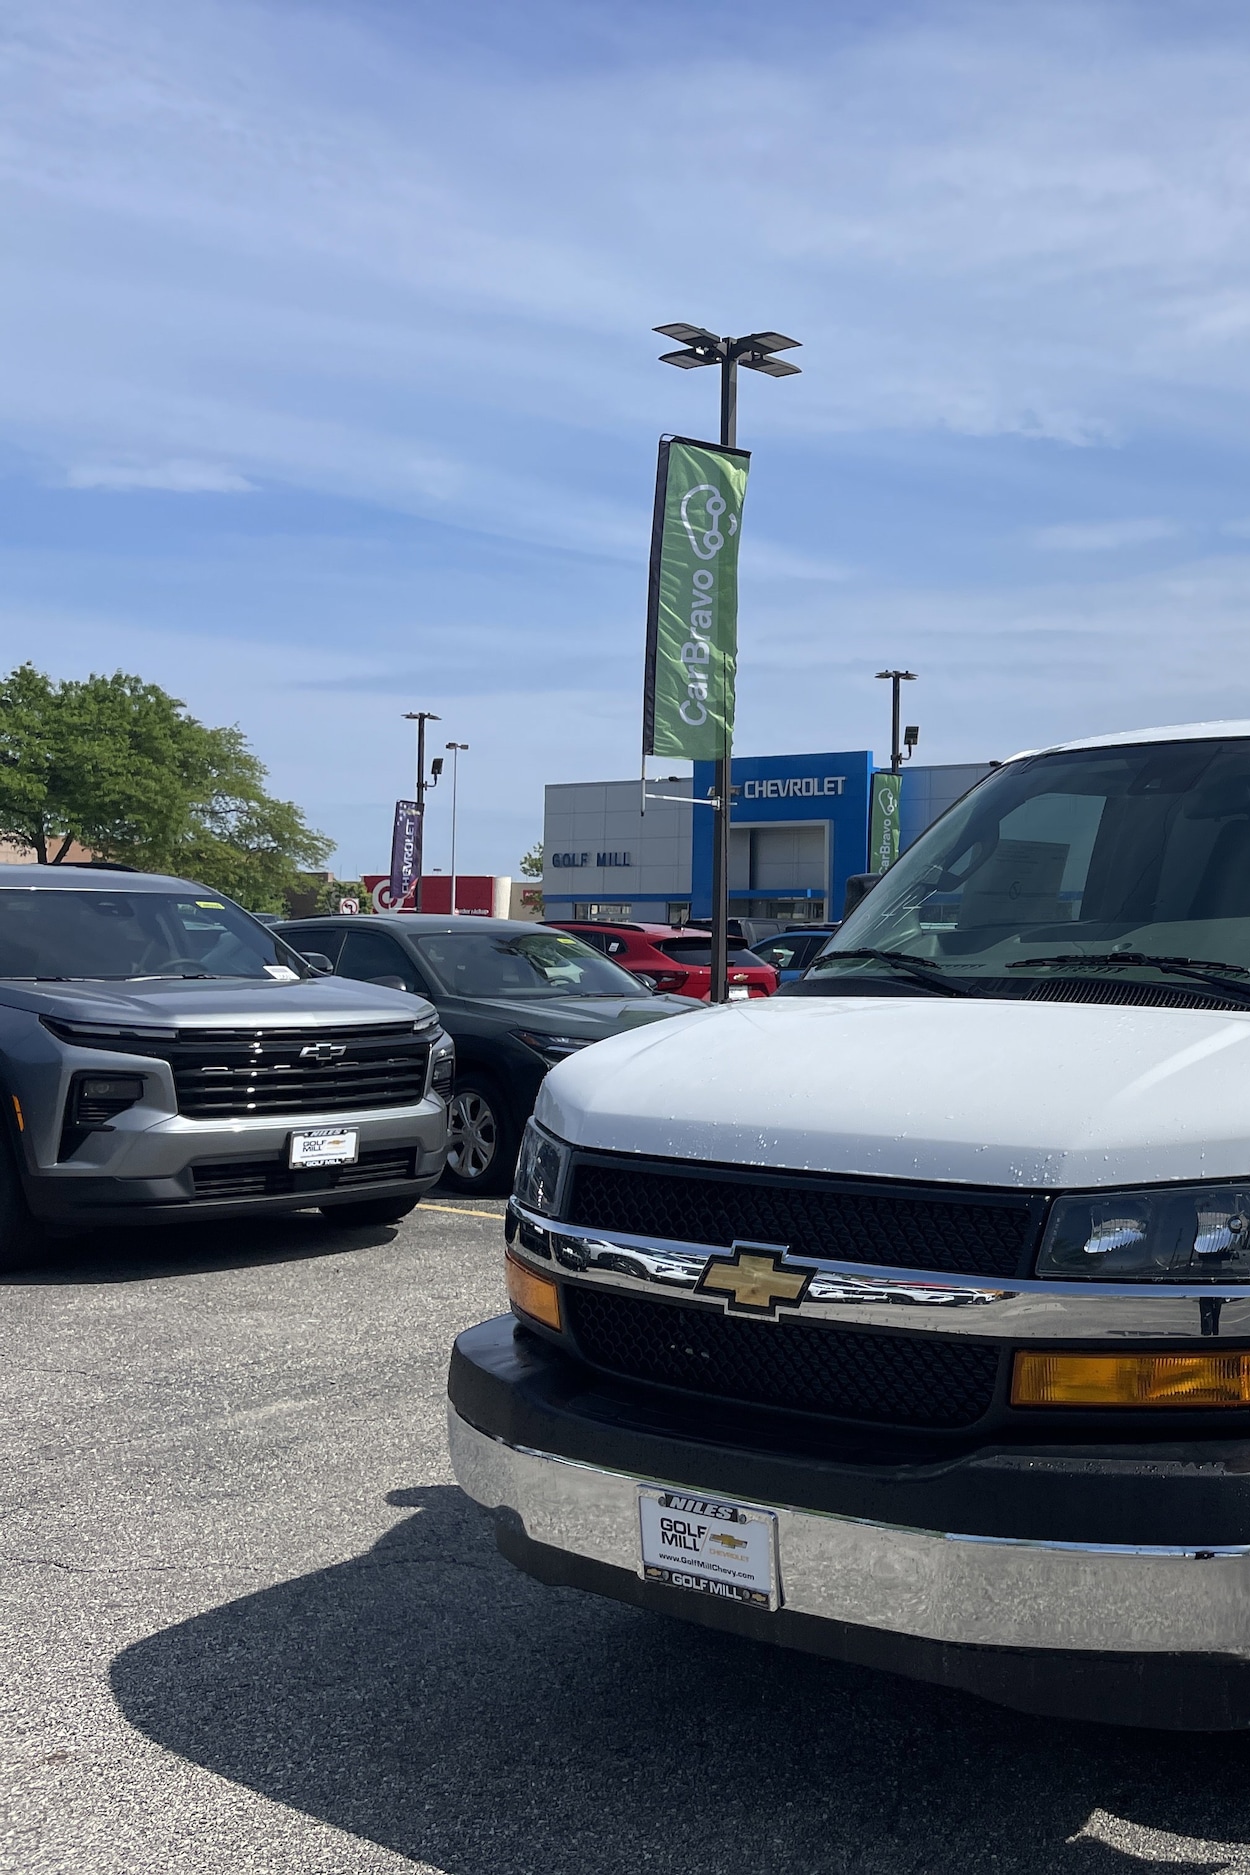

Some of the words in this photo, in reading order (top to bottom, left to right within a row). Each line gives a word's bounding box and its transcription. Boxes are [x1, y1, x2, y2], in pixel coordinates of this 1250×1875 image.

[679, 569, 714, 726] CarBravo
[744, 776, 846, 799] CHEVROLET
[402, 818, 415, 894] CHEVROLET
[552, 852, 588, 868] GOLF
[596, 851, 631, 867] MILL
[669, 1496, 734, 1520] NILES
[660, 1517, 707, 1539] GOLF
[661, 1531, 701, 1552] MILL
[658, 1552, 755, 1581] www.GolfMillChevy.com
[709, 1548, 749, 1563] CHEVROLET
[671, 1572, 708, 1591] GOLF
[709, 1582, 743, 1600] MILL
